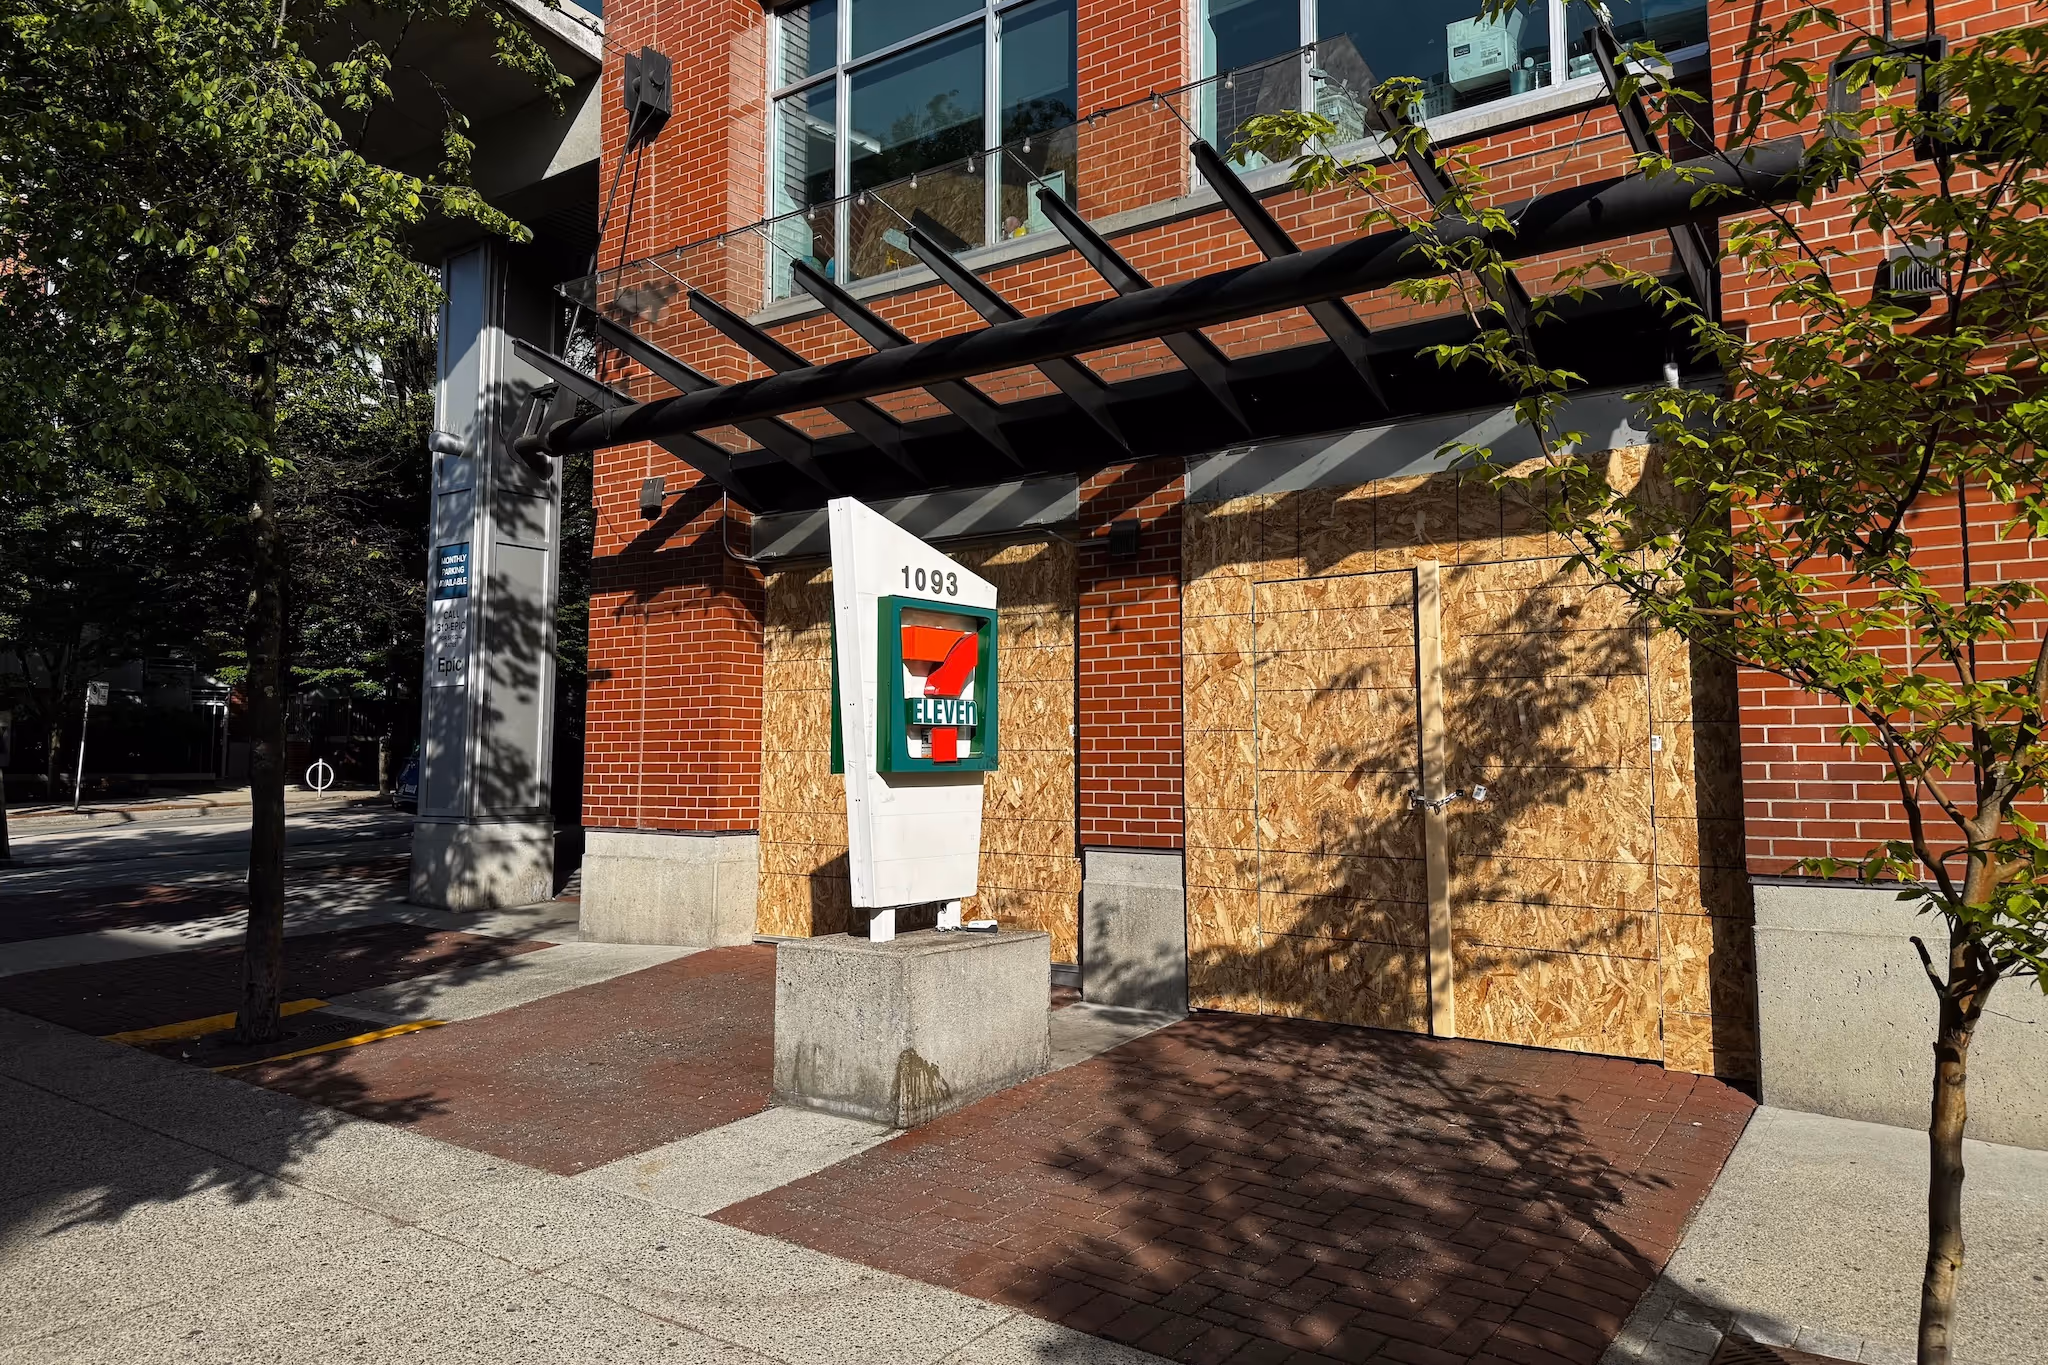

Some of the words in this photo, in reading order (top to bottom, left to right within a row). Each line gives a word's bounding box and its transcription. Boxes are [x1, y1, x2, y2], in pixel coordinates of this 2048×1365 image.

[441, 554, 467, 565] MONTHLY
[441, 566, 465, 576] PARKING
[438, 577, 467, 588] AVAILABLE
[901, 565, 959, 596] 1093
[443, 610, 460, 619] CALL
[438, 657, 462, 676] Epic
[901, 626, 979, 762] 7
